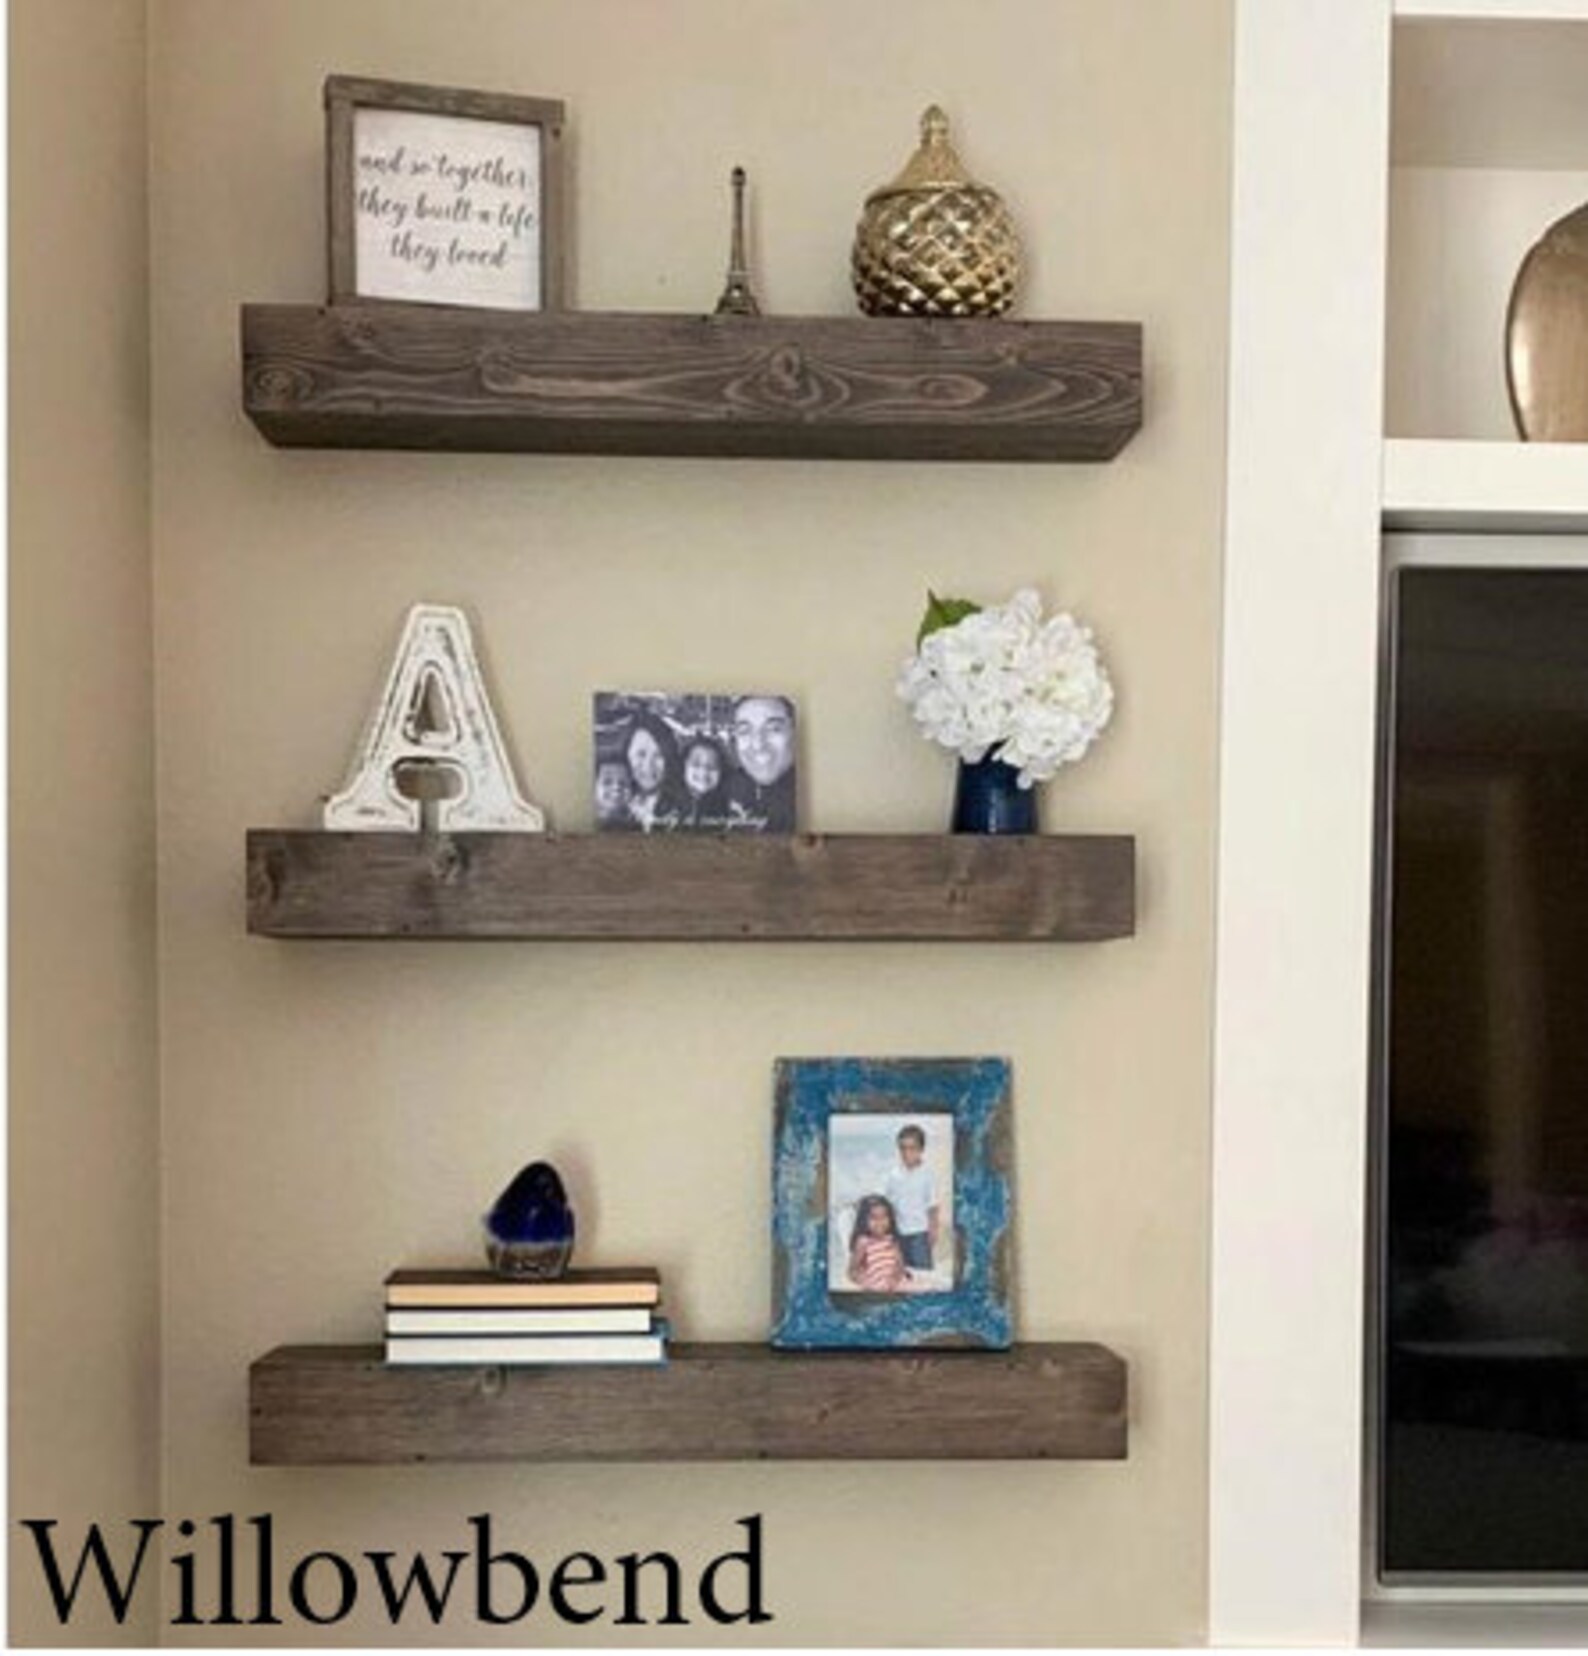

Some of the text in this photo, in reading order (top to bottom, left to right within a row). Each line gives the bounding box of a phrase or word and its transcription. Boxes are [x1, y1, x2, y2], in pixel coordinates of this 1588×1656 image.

[359, 147, 526, 191] and so together
[359, 186, 535, 239] they built a life
[391, 231, 509, 273] they loved
[324, 602, 545, 832] A
